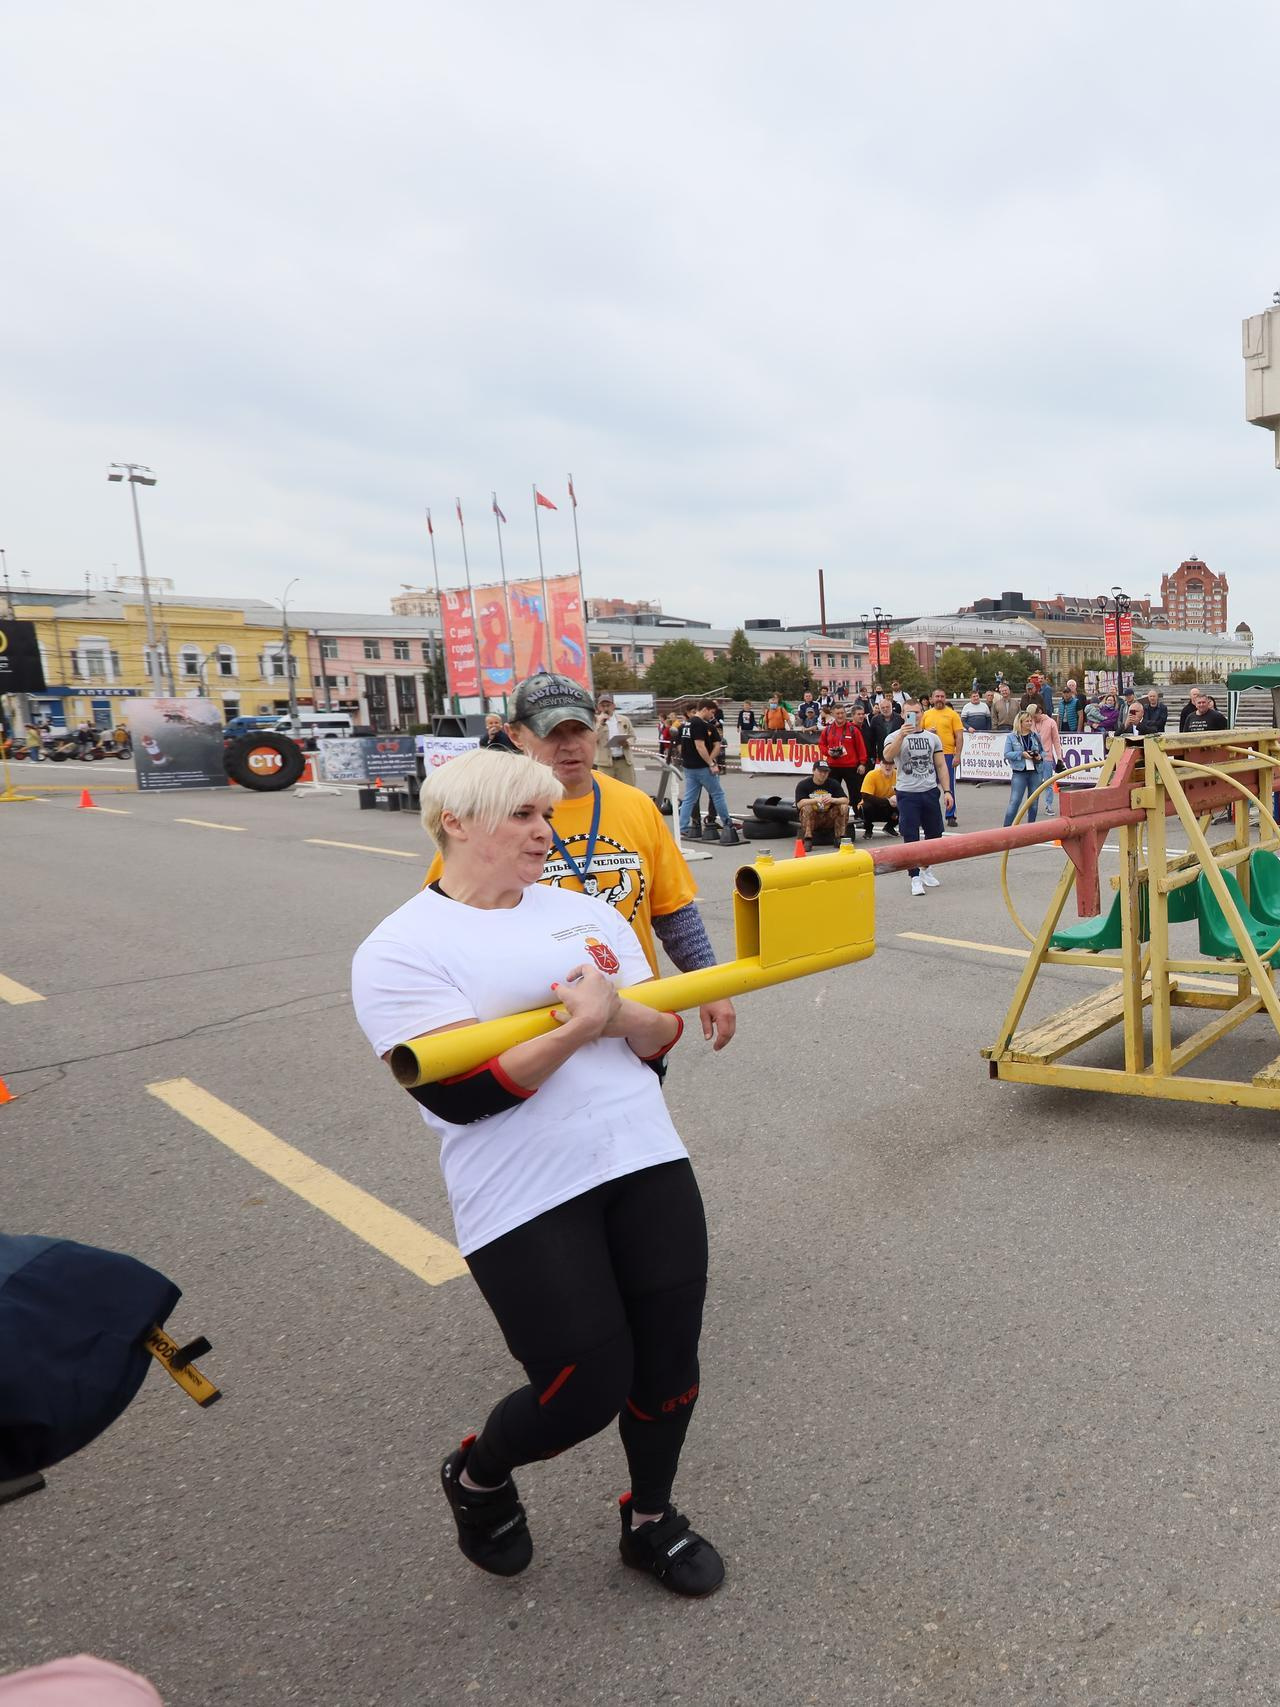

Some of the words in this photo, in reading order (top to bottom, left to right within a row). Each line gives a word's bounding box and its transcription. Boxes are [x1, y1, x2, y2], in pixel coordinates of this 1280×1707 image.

[78, 688, 130, 696] АПТЕКА
[908, 737, 930, 750] СВОЯ
[748, 738, 785, 762] СИЛА
[593, 857, 636, 867] ЧЕЛОВЕК
